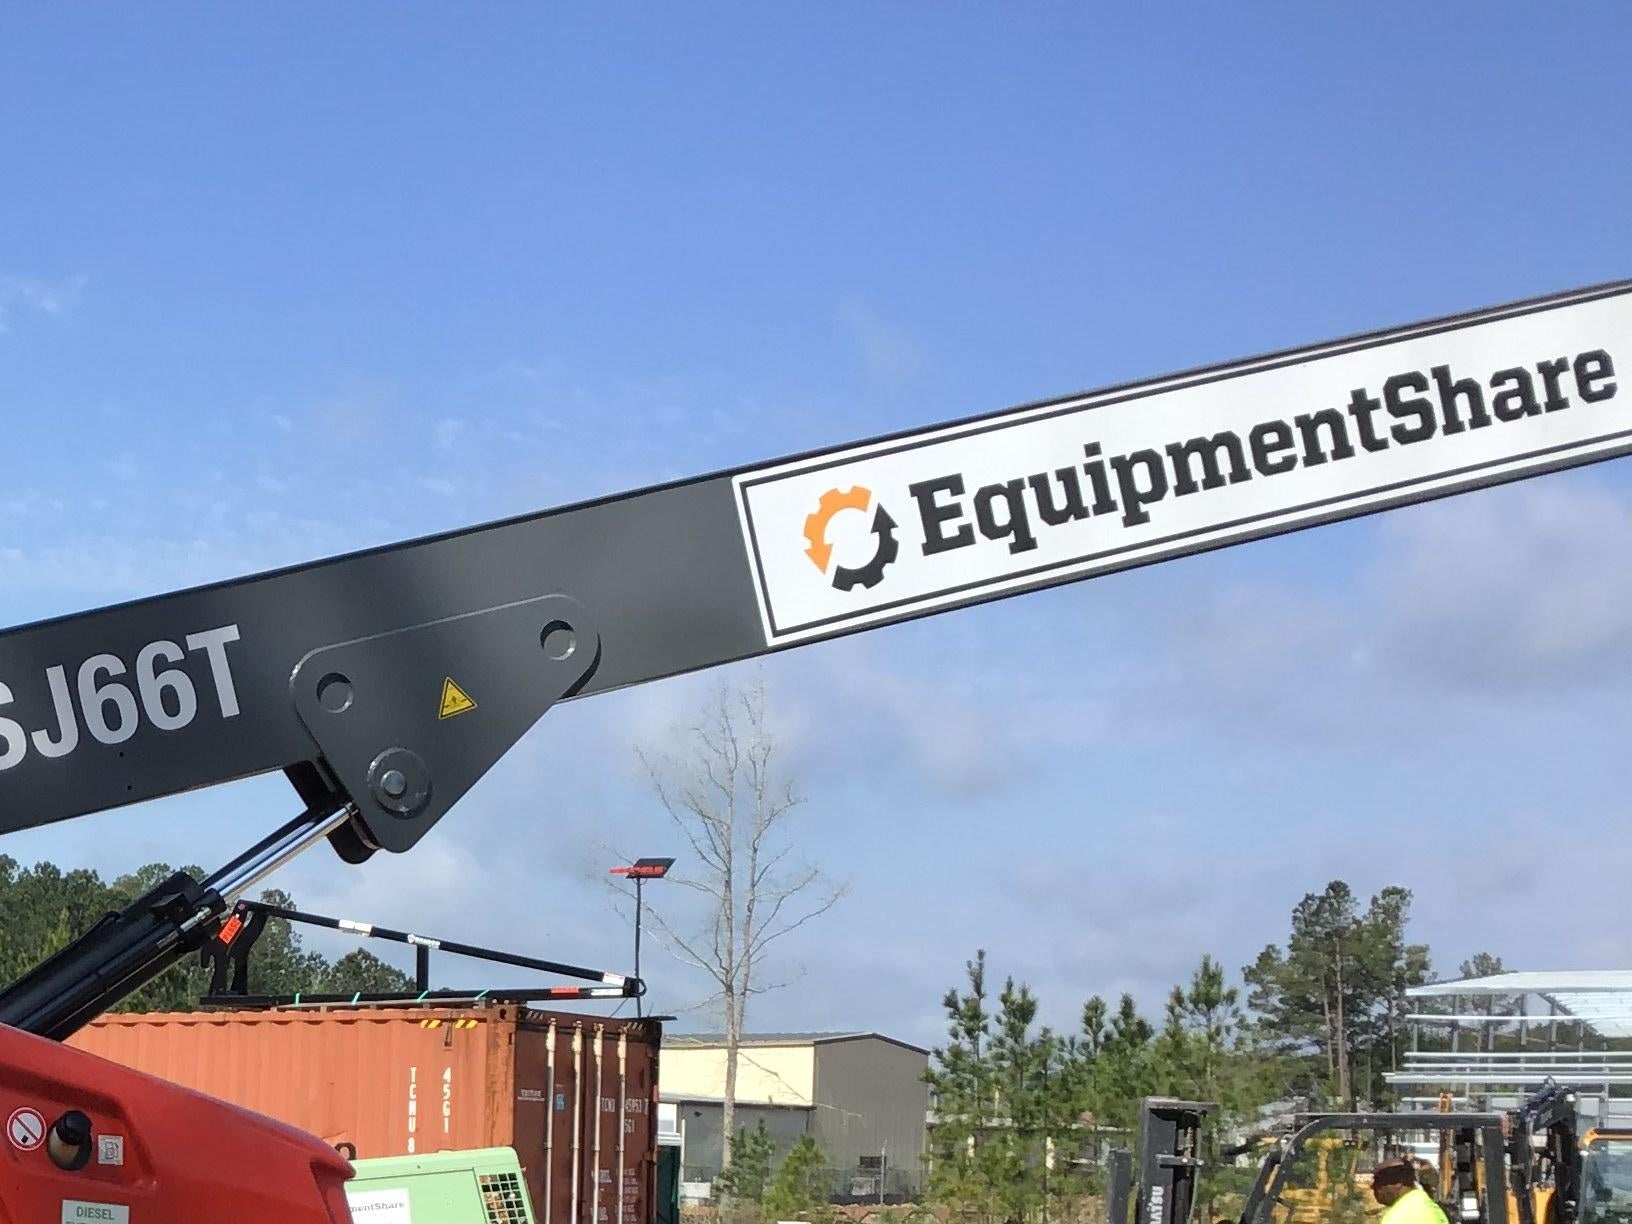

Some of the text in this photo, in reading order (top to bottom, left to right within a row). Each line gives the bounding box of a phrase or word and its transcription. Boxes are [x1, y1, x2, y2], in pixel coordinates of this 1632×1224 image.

[909, 348, 1618, 557] EquipmentShare
[442, 1067, 452, 1134] 45G1
[76, 1206, 114, 1220] DIESEL
